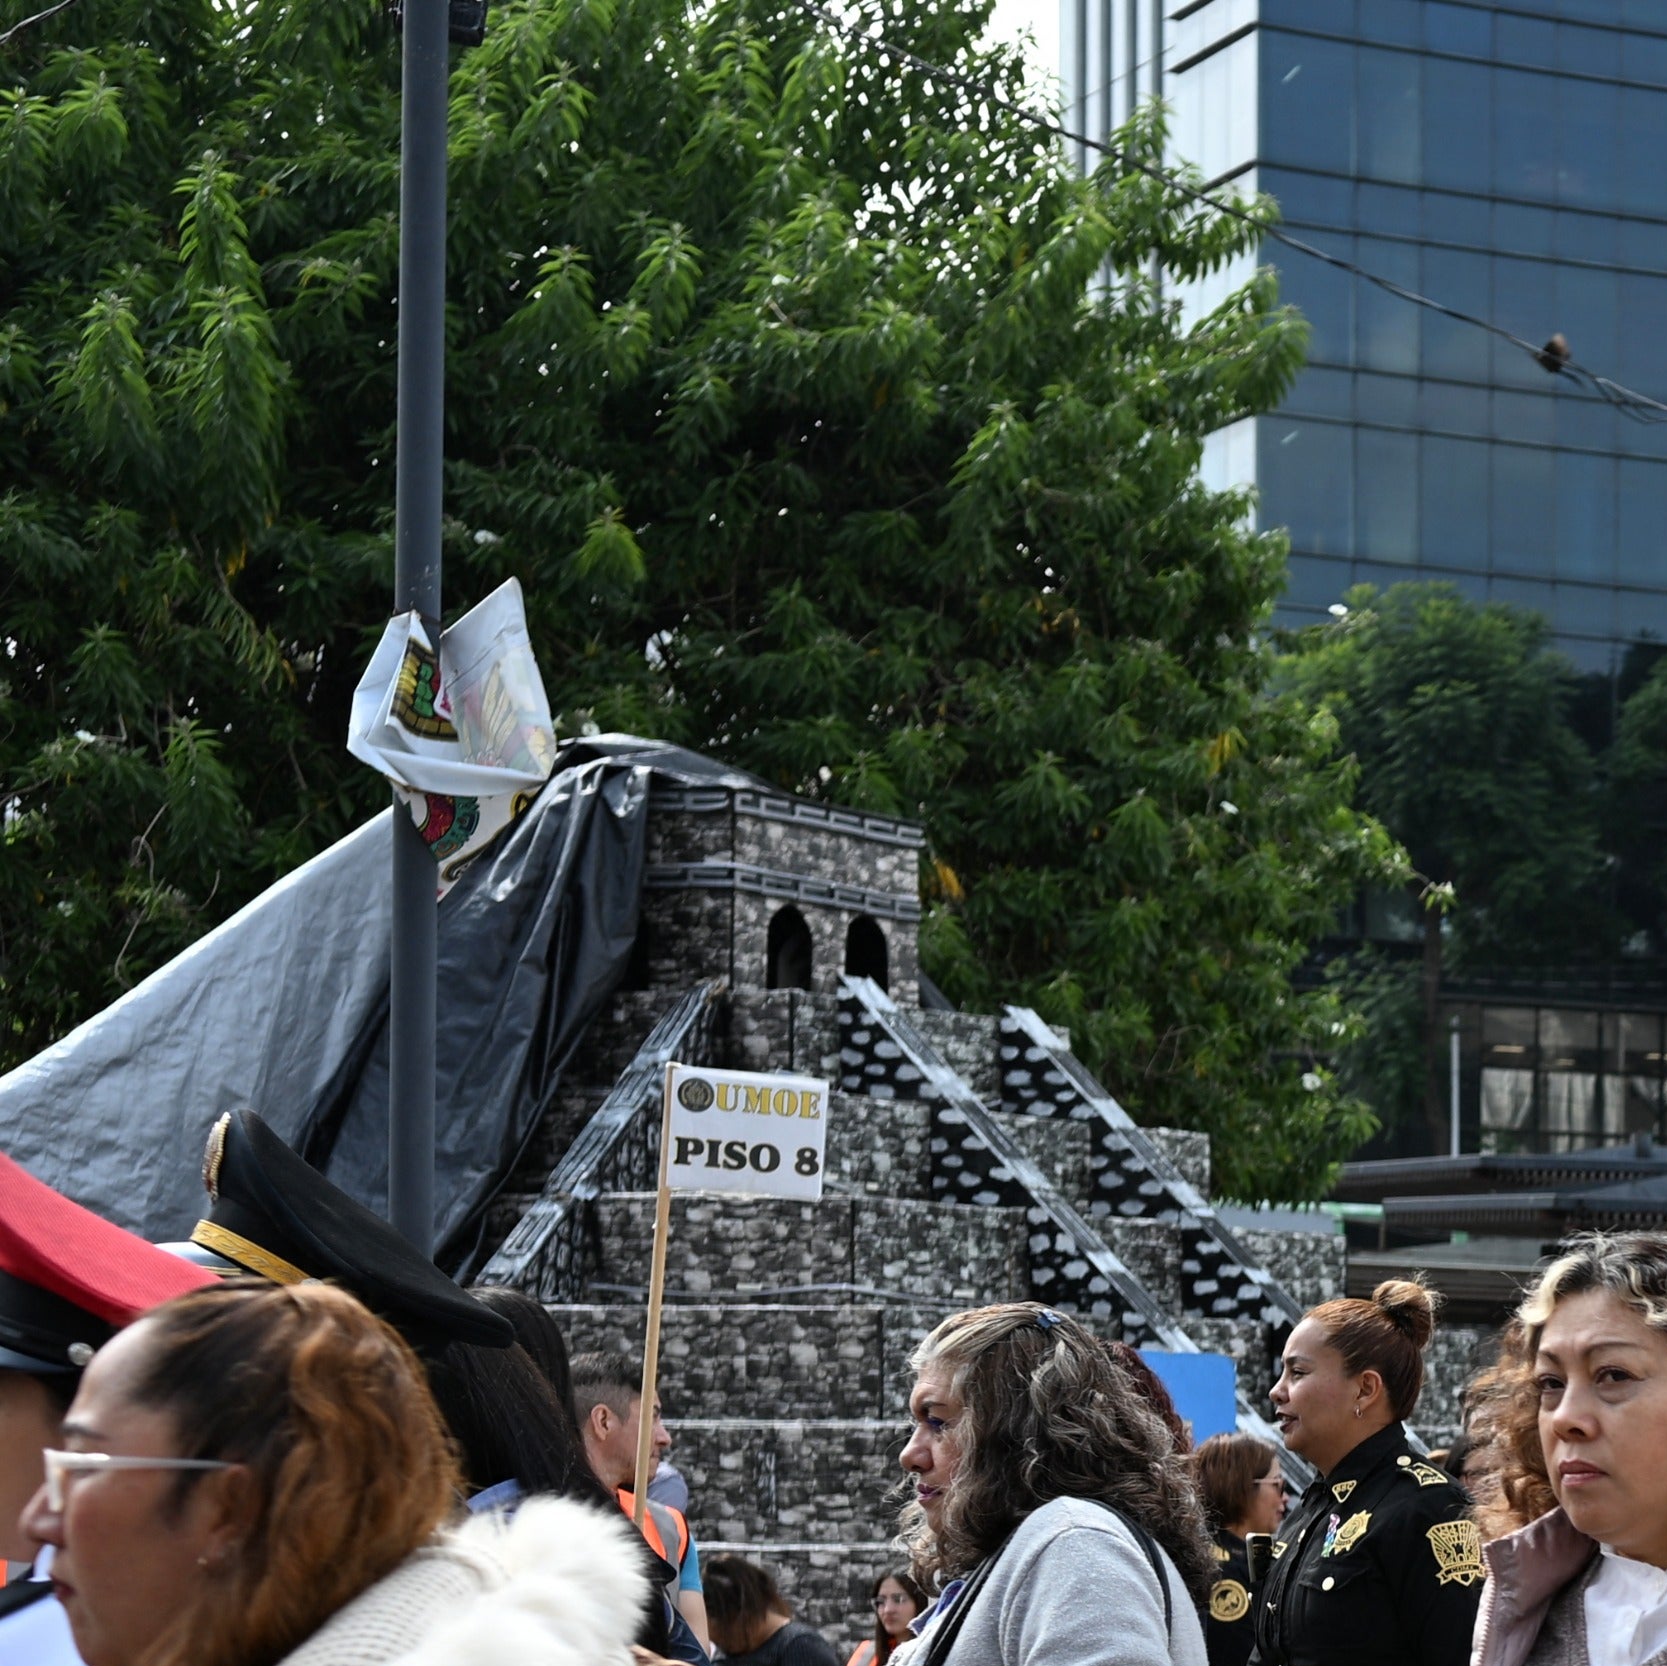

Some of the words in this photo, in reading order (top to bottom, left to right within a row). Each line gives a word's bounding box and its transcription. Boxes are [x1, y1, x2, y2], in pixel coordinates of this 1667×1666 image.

[715, 1083, 822, 1120] UMOE
[674, 1136, 781, 1173] PISO
[794, 1147, 819, 1176] 8
